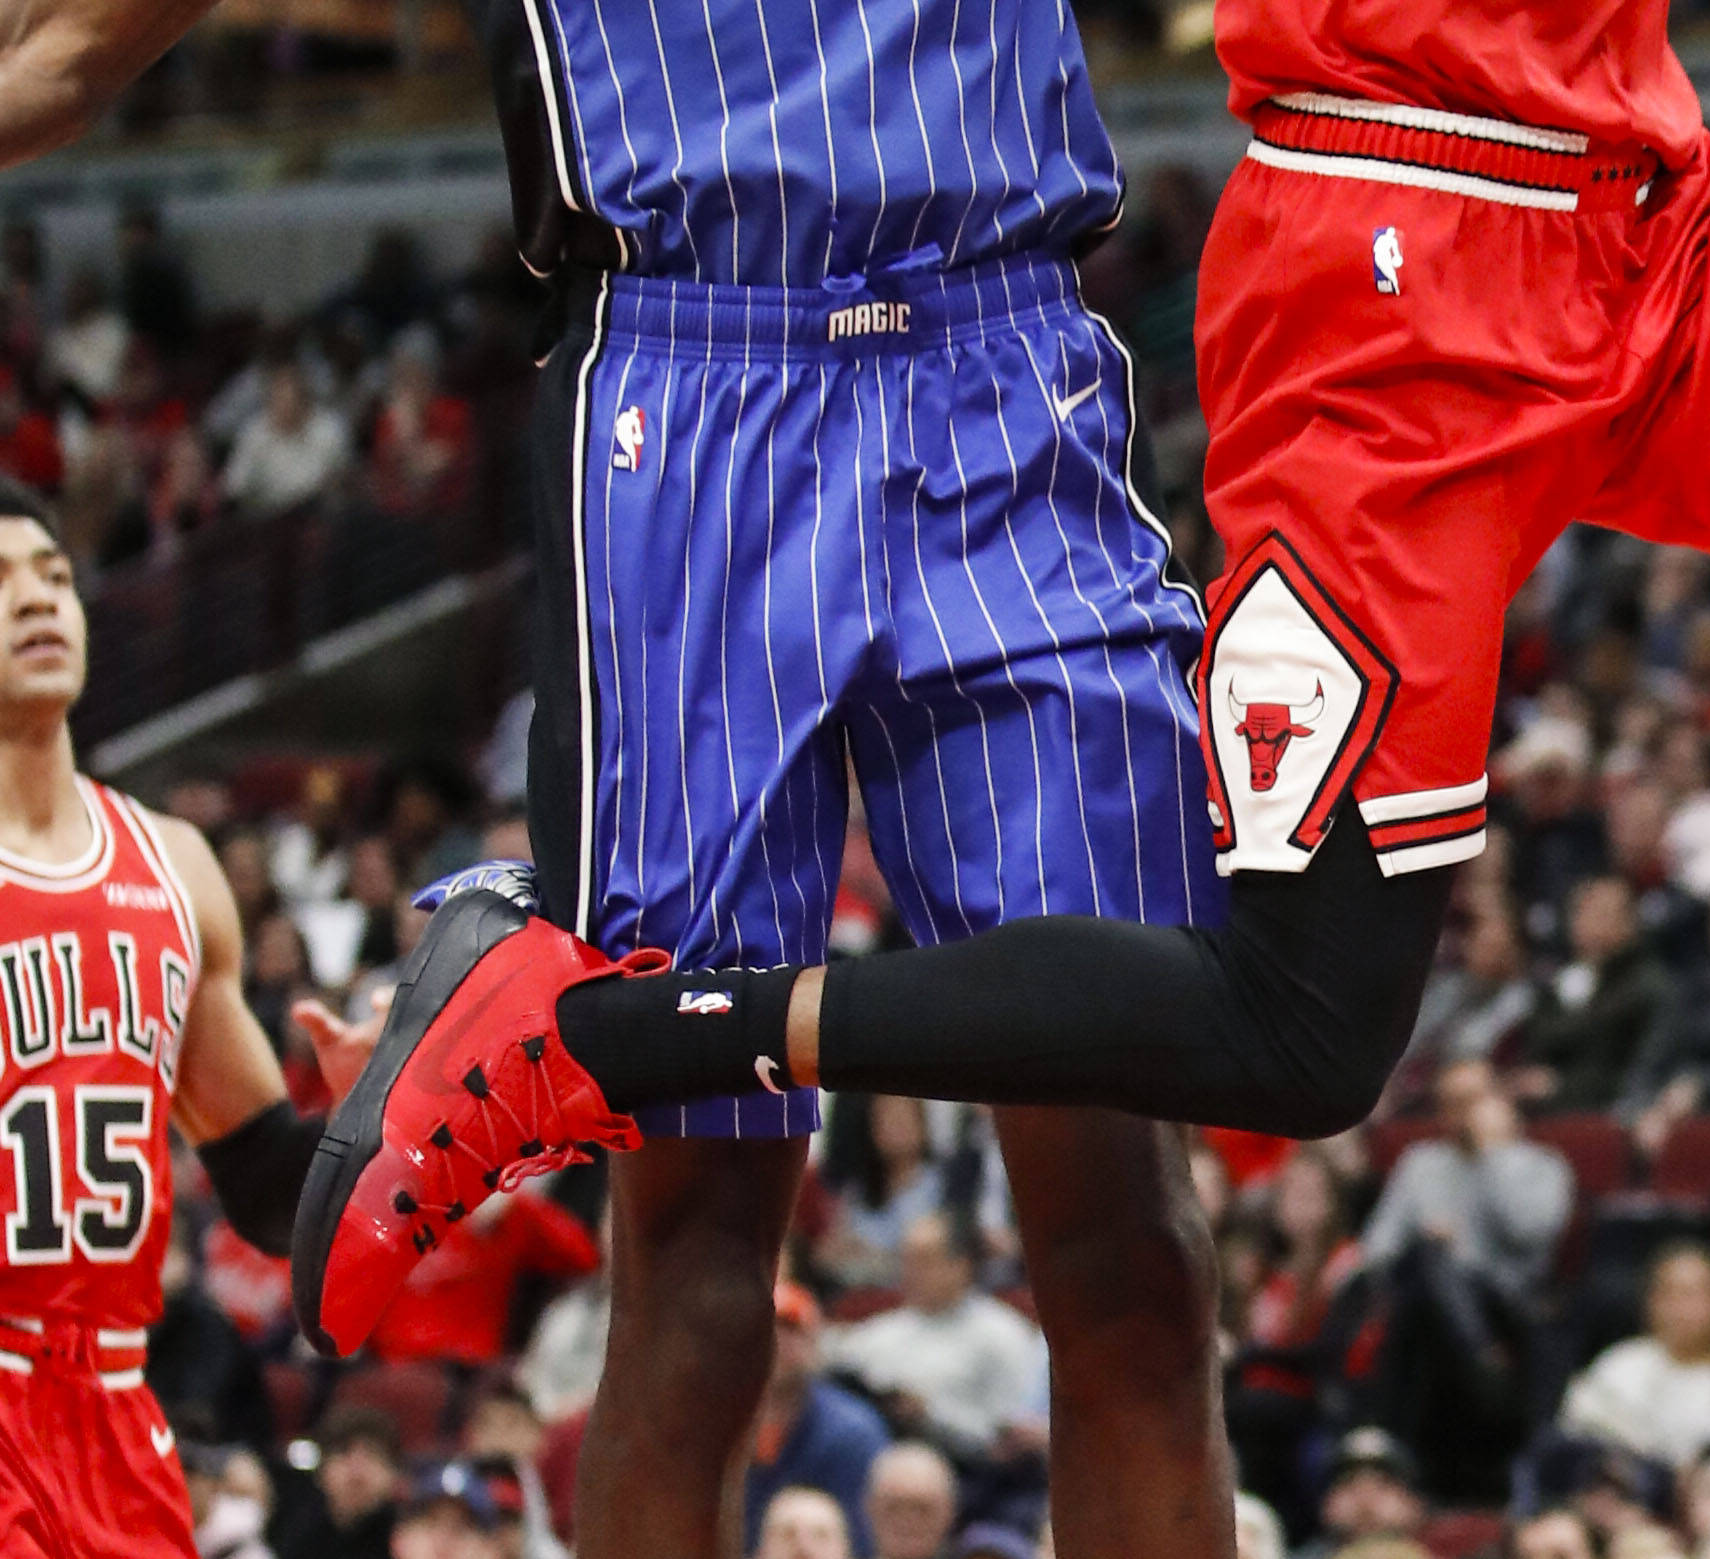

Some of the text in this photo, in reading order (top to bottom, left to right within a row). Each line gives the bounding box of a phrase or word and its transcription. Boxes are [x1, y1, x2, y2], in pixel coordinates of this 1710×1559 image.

[828, 302, 911, 342] MAGIC
[0, 930, 189, 1096] ULLS
[0, 1086, 153, 1265] 15
